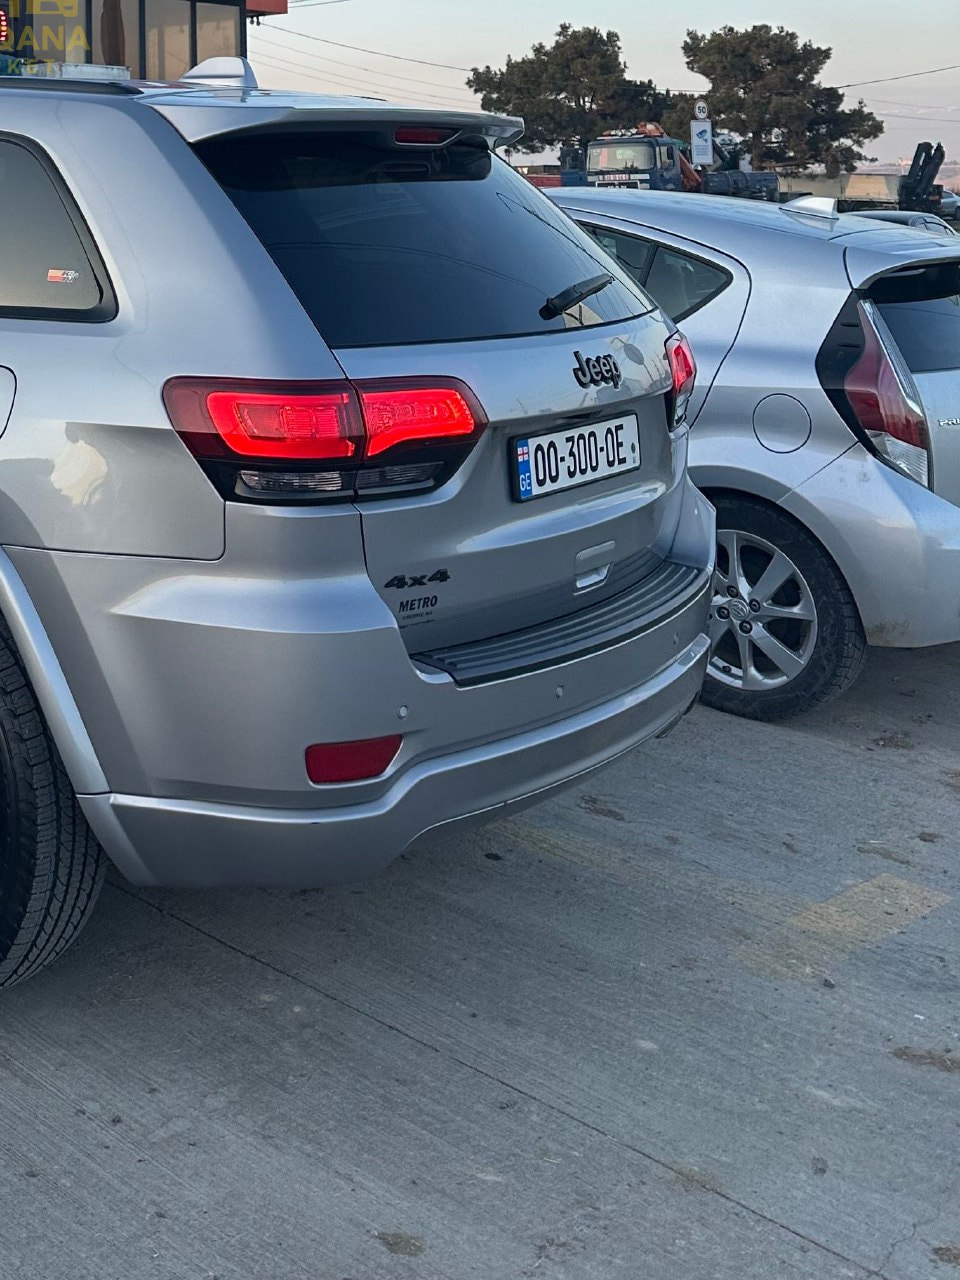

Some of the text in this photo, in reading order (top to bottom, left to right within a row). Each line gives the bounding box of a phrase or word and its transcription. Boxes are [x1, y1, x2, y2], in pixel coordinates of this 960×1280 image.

[697, 106, 706, 114] 50
[573, 350, 622, 389] Jeep
[519, 474, 532, 492] GE
[384, 569, 450, 589] 4x4
[399, 595, 438, 613] METRO
